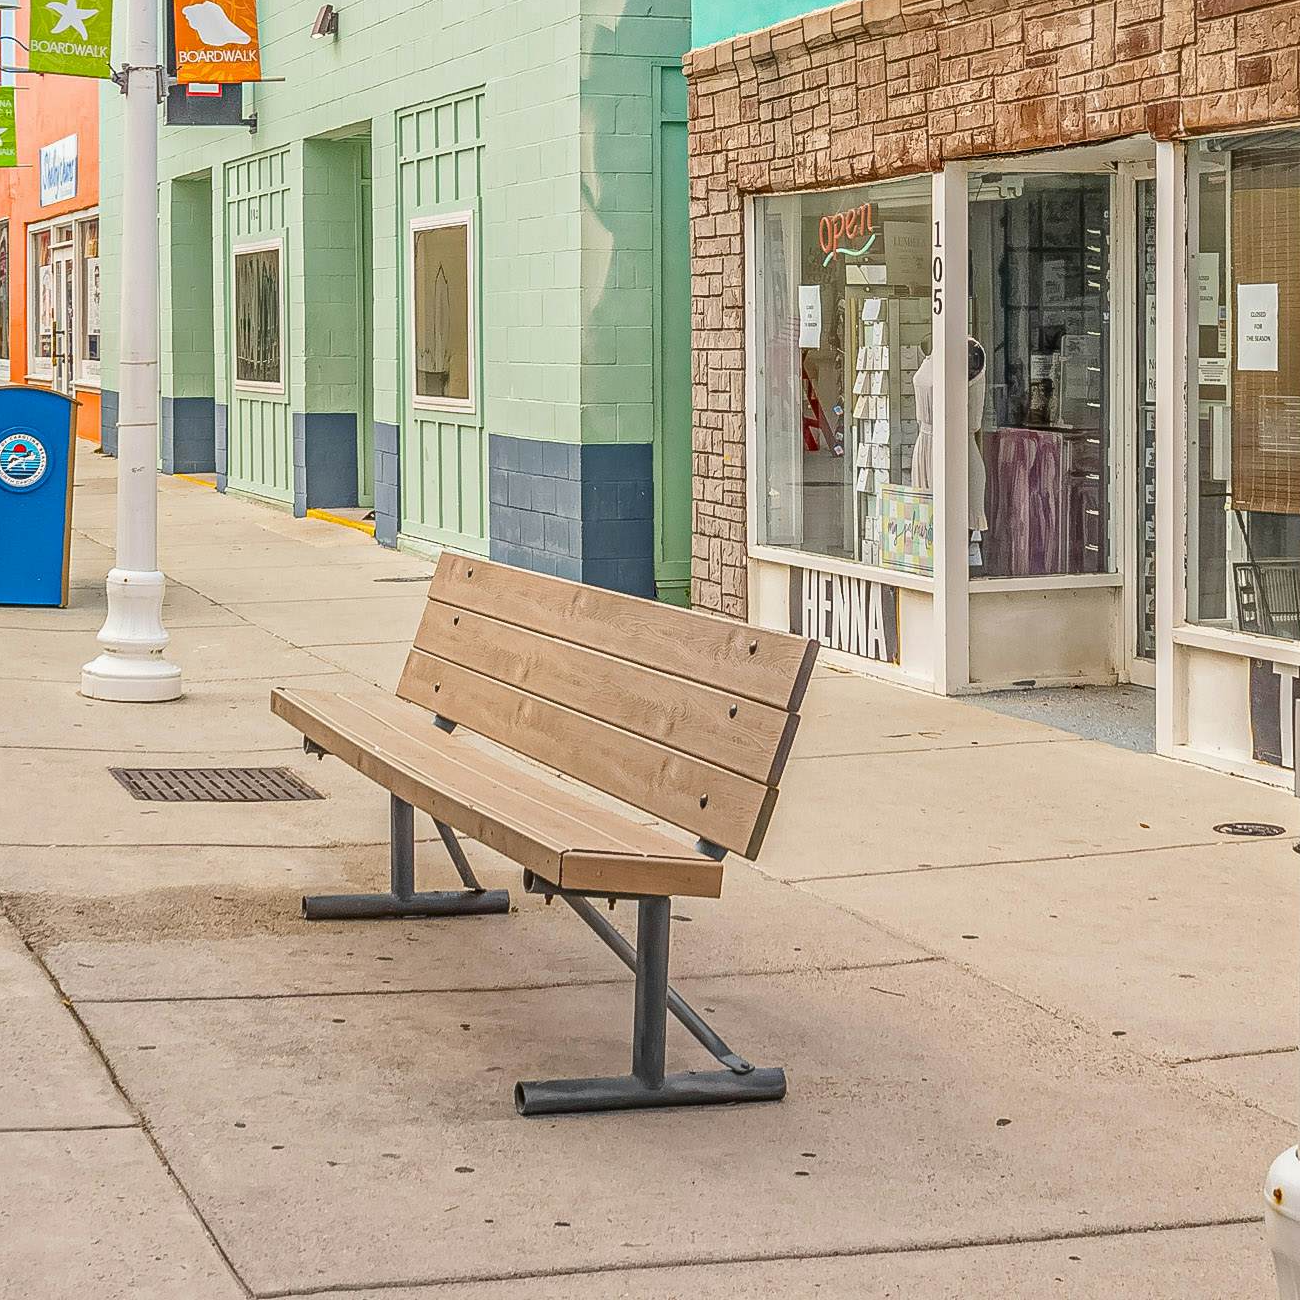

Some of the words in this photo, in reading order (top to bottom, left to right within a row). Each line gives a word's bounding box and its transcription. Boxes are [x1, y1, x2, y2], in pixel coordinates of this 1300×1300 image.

[30, 39, 108, 59] BOARDWALK
[178, 49, 258, 64] BOARDWALK
[932, 221, 943, 315] 105
[802, 567, 888, 662] HENNA
